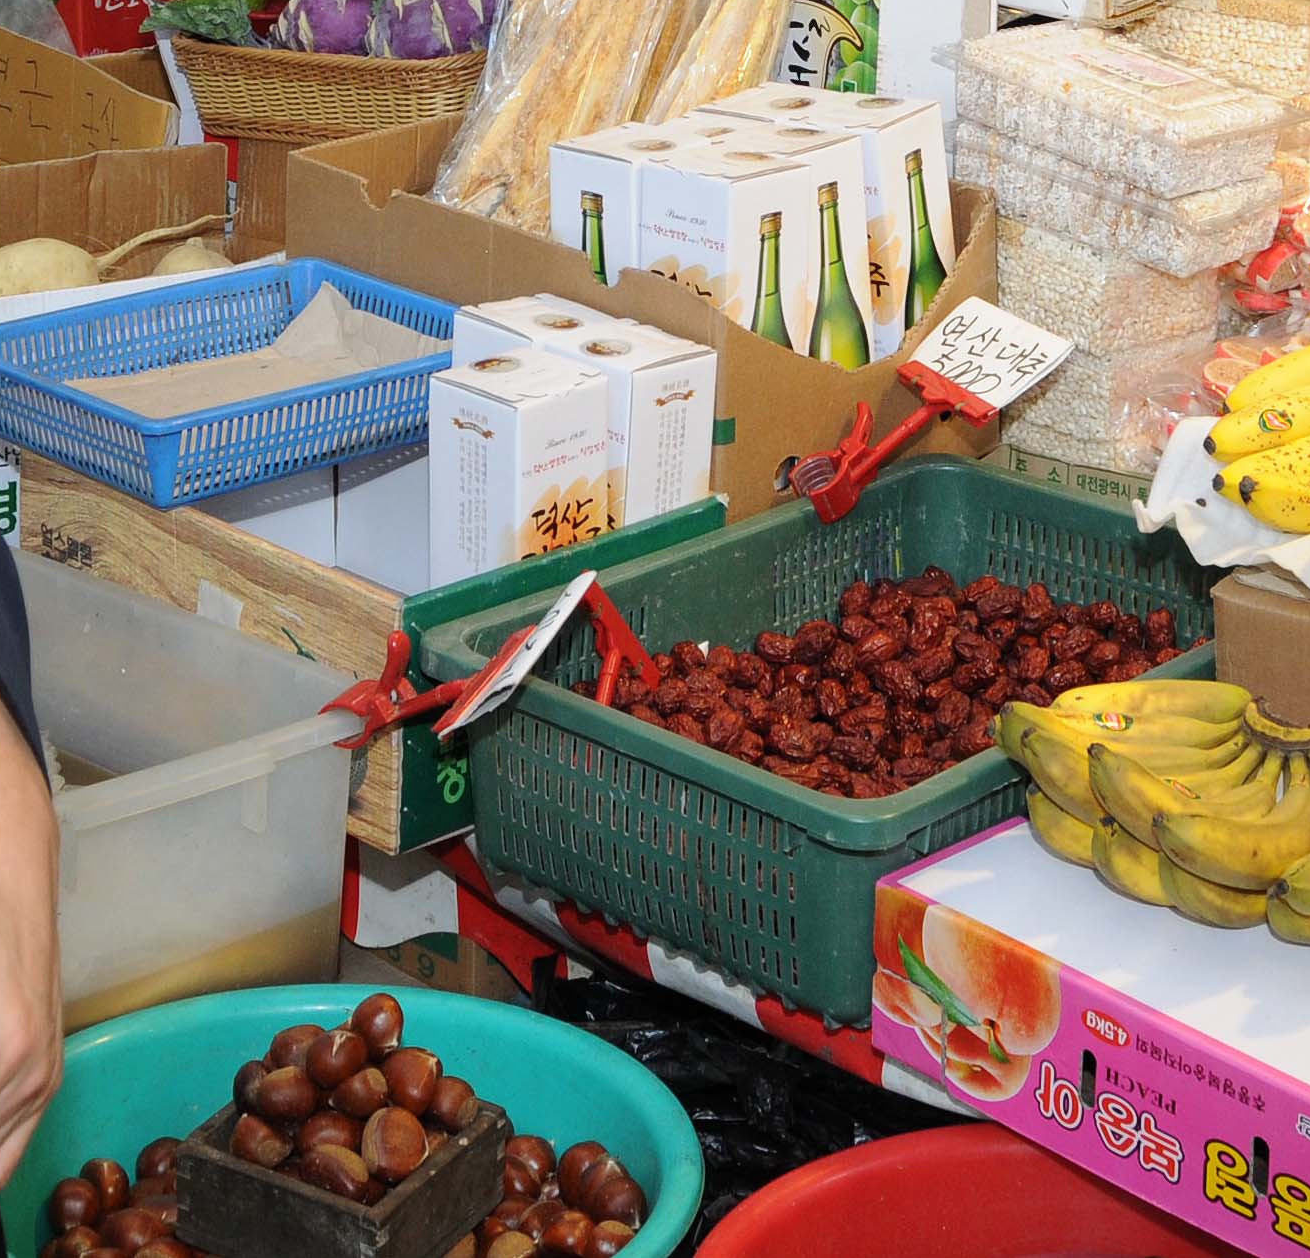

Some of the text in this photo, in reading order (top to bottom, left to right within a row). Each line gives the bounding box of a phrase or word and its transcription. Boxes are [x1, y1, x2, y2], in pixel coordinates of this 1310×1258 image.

[1075, 472, 1131, 500] 대전광역시
[1086, 1014, 1129, 1047] 4.5kg
[1104, 1066, 1178, 1116] PEACH
[1035, 1060, 1185, 1185] 복숭아
